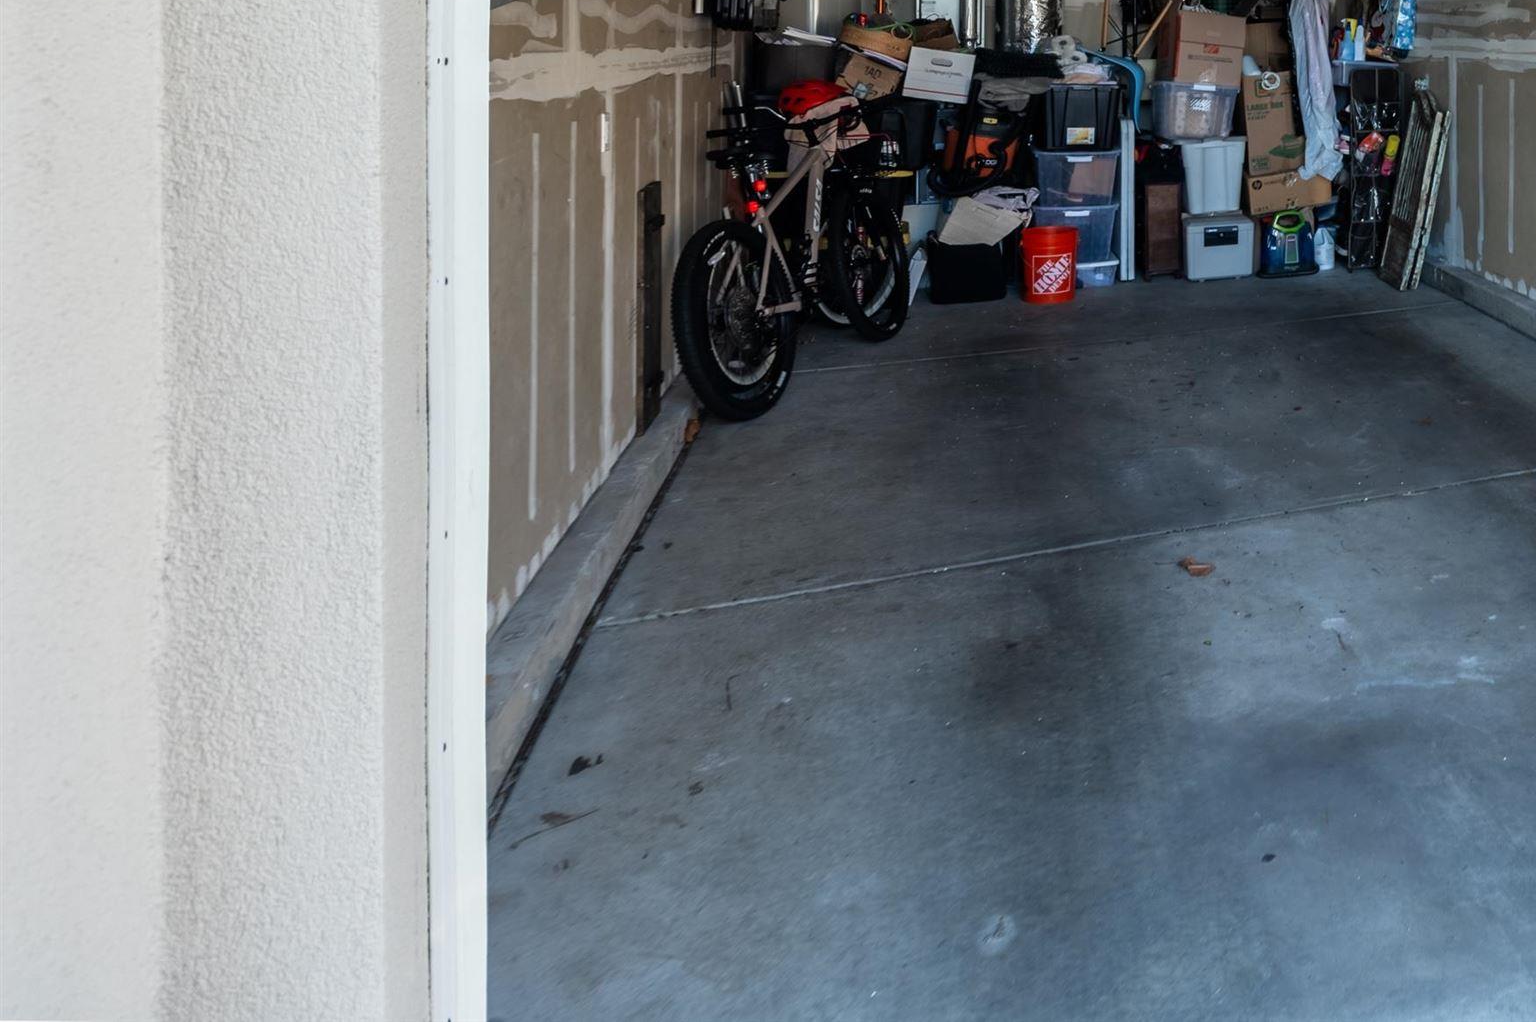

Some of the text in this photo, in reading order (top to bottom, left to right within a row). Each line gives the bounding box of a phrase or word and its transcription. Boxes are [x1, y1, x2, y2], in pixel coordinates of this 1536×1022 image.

[1034, 254, 1070, 293] HOME
[1036, 259, 1054, 275] THE
[1048, 266, 1071, 293] DEPOT
